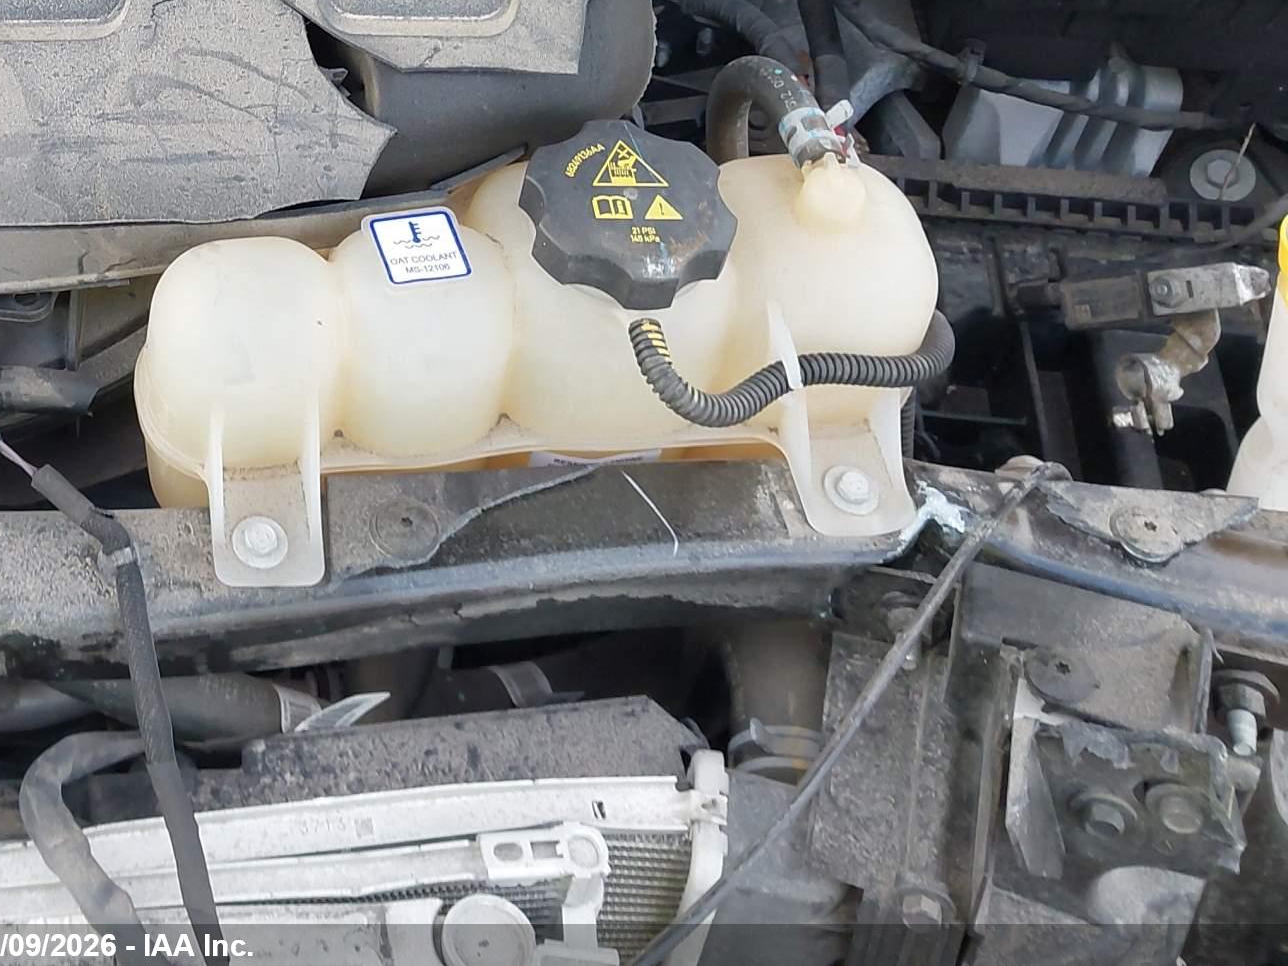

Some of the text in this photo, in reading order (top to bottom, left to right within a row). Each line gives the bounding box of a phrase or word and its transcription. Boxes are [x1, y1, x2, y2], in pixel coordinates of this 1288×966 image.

[631, 226, 656, 235] 21 PSI
[411, 251, 457, 263] COOLANT
[405, 263, 450, 274] MS-12106
